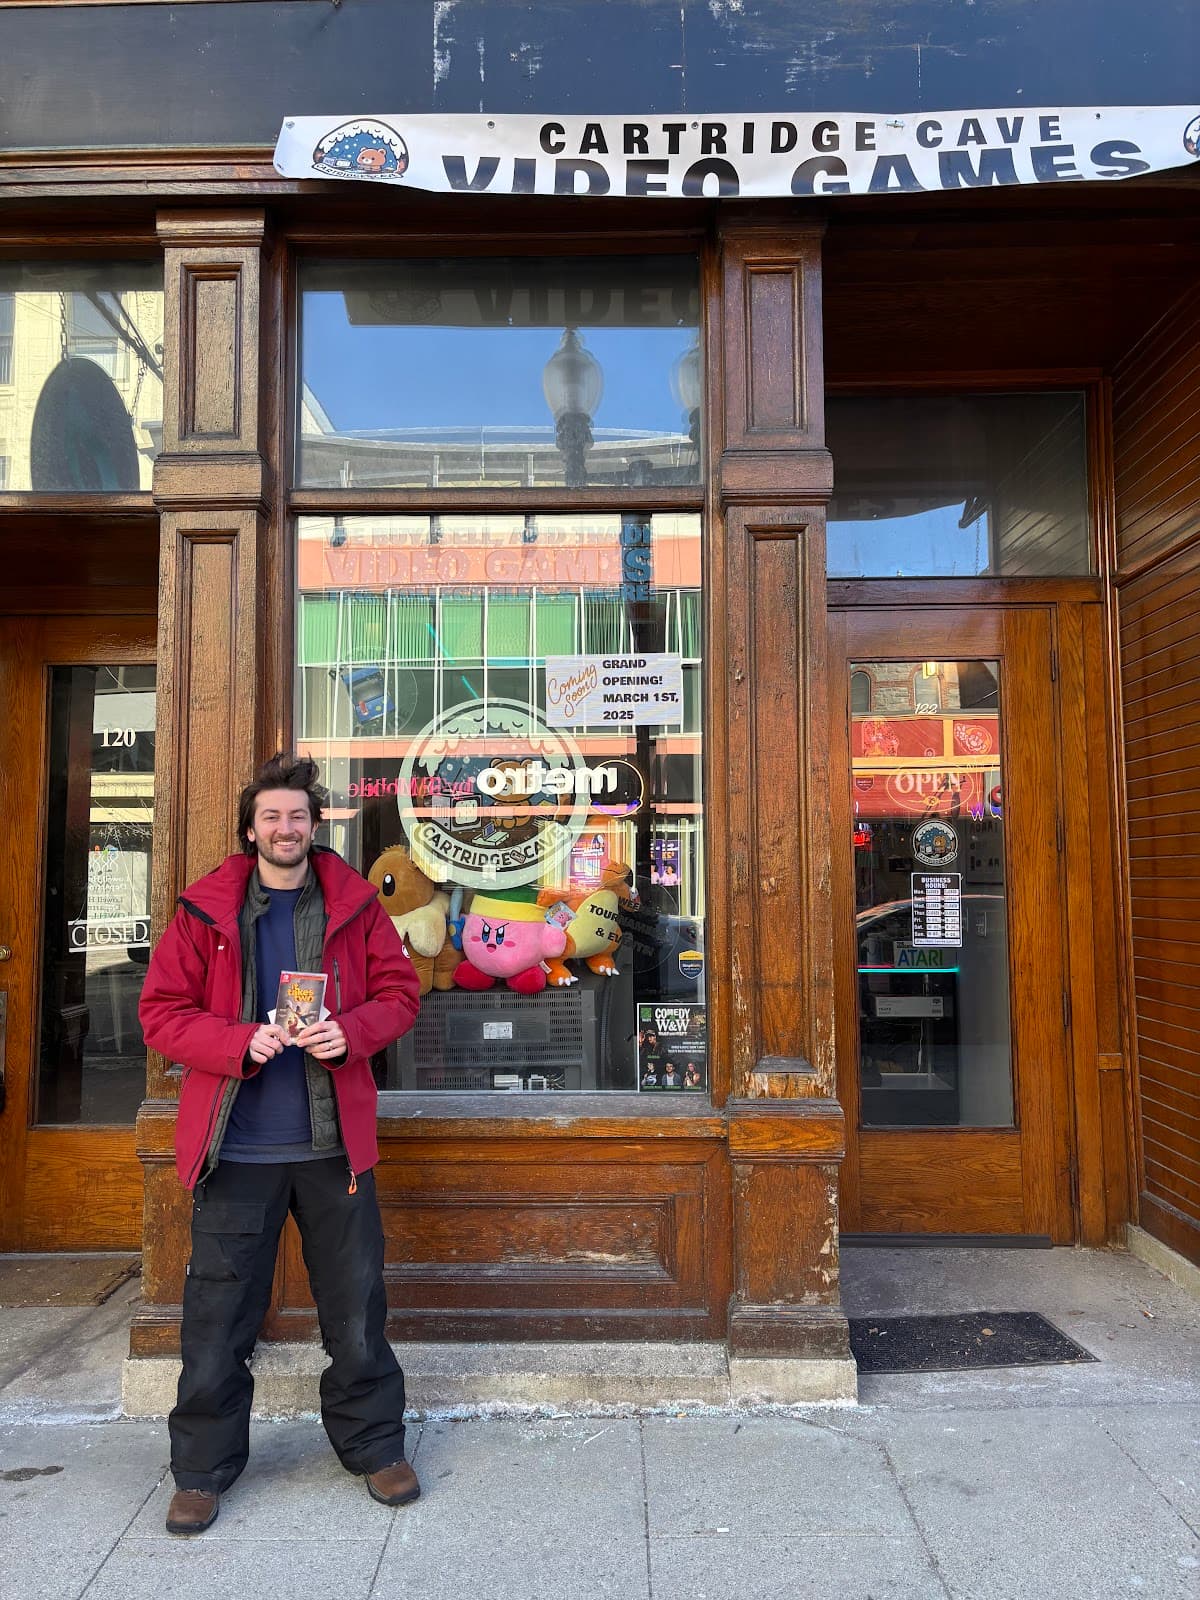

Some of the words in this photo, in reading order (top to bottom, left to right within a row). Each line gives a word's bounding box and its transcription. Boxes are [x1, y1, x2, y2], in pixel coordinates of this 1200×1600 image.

[539, 120, 877, 155] CARTRIDGE
[915, 114, 1063, 149] CAVE
[441, 154, 741, 197] VIDEO
[790, 140, 1152, 196] GAMES
[324, 548, 471, 583] VIDEO
[485, 546, 654, 582] GAMES
[603, 659, 647, 669] GRAND
[548, 664, 598, 704] Coming
[602, 675, 663, 686] OPENING!
[603, 693, 649, 703] MARCH
[653, 692, 679, 703] 1ST,
[603, 710, 635, 720] 2025
[914, 703, 938, 715] 122
[100, 727, 136, 748] 120
[893, 771, 963, 797] OPEN
[423, 826, 512, 867] CARTRIDGE
[71, 920, 148, 948] CLOSED
[595, 927, 605, 938] &
[897, 949, 943, 967] ATARI
[654, 1007, 691, 1019] COMEDY
[655, 1018, 690, 1032] W&W
